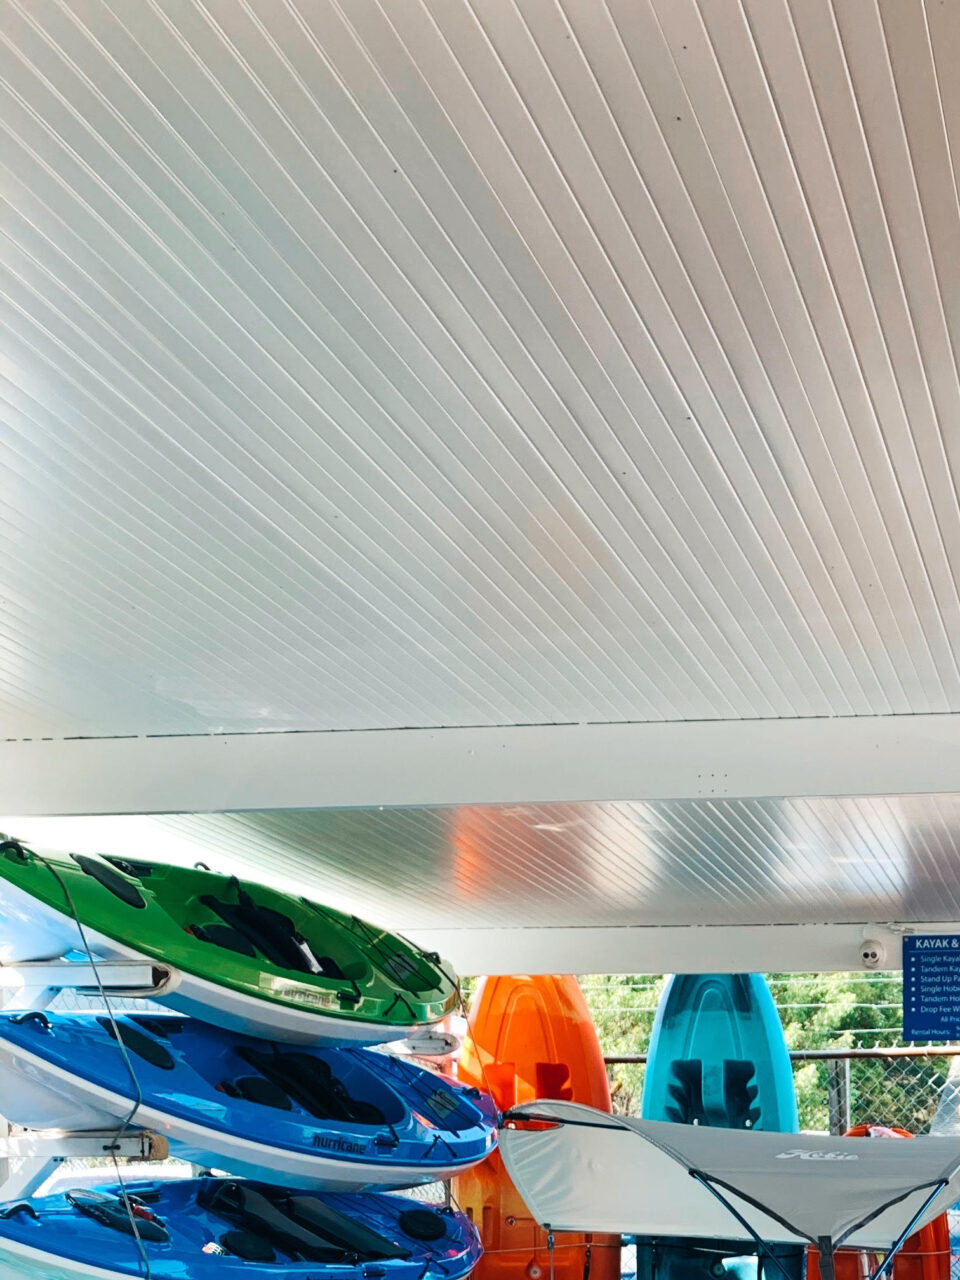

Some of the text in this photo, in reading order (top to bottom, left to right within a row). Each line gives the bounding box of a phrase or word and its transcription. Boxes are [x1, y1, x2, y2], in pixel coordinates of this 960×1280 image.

[916, 938, 949, 949] KAYAK
[951, 938, 960, 948] &
[920, 955, 942, 964] Single
[921, 965, 949, 973] Tandem
[920, 975, 941, 983] Stand
[941, 975, 952, 983] Up
[920, 985, 942, 994] Single
[920, 1006, 938, 1014] Drop
[939, 1005, 952, 1013] Fee
[312, 1132, 367, 1155] hurricane
